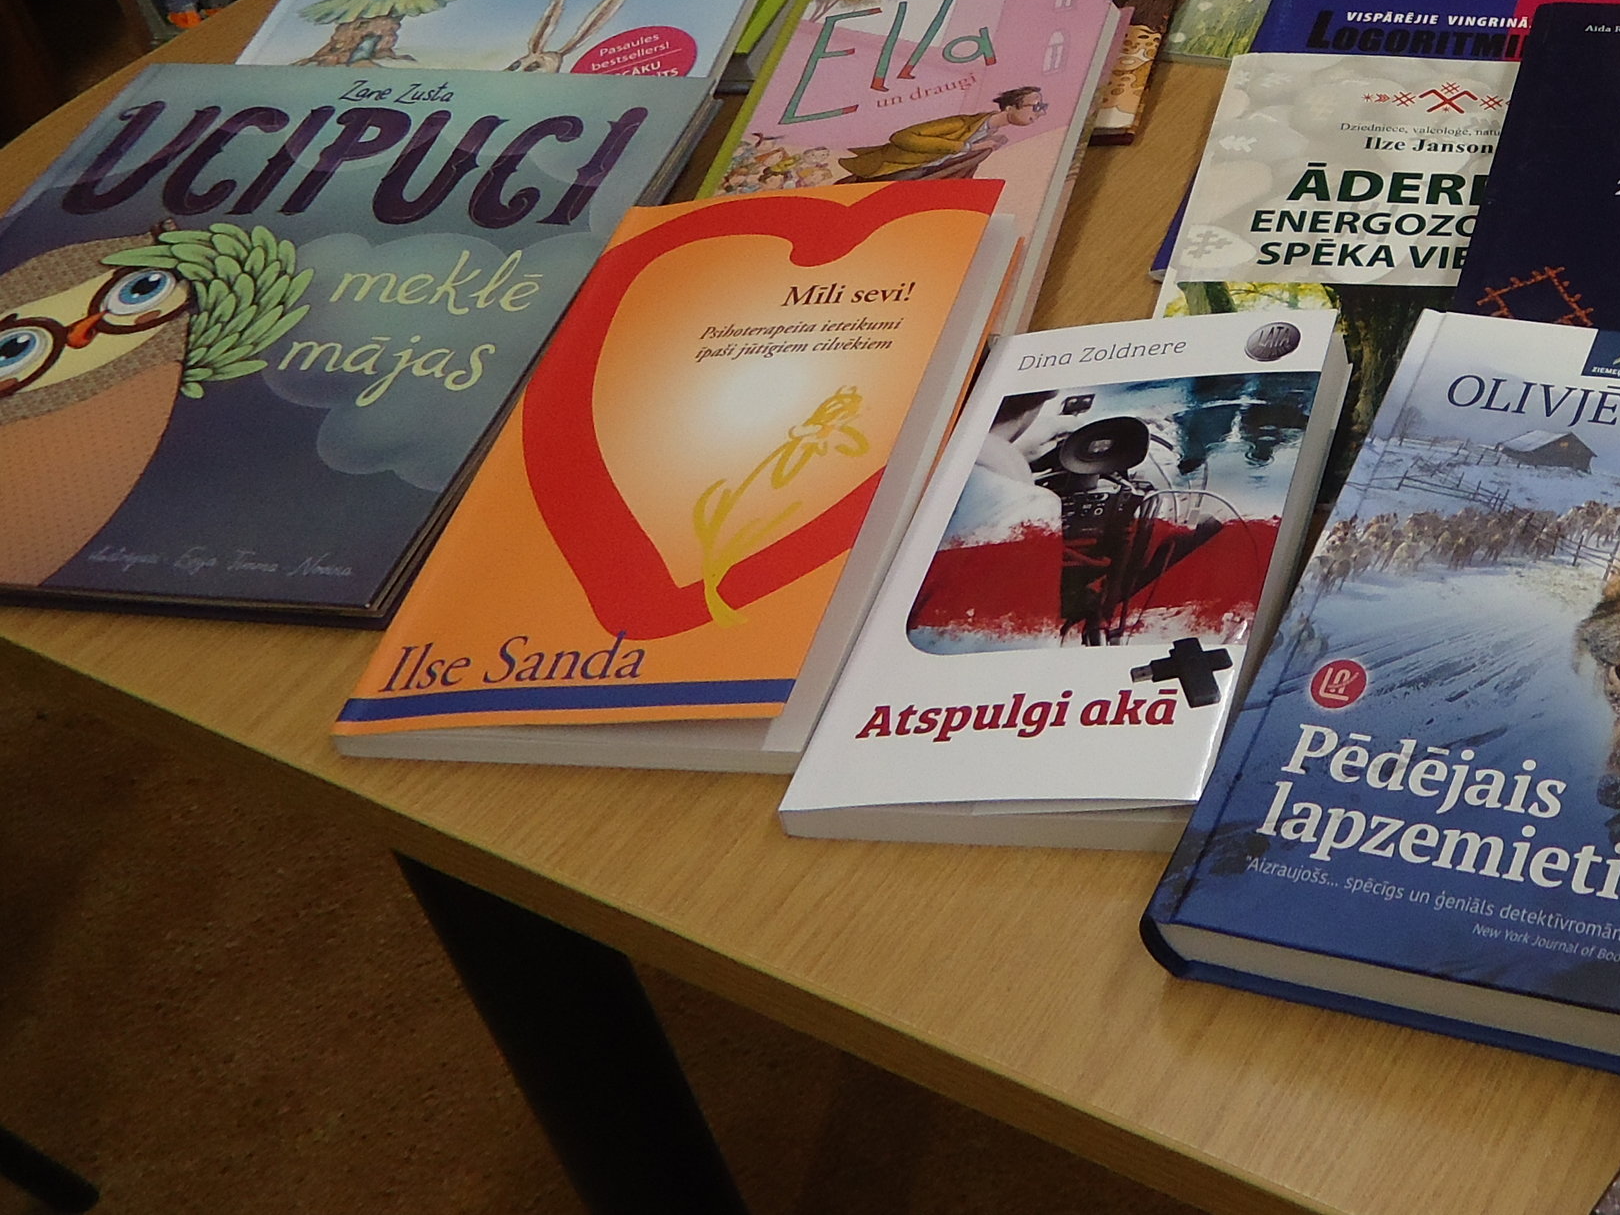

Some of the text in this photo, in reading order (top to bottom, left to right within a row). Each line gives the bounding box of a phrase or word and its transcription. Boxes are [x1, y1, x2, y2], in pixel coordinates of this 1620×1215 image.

[600, 34, 660, 56] Pasaules
[1584, 24, 1612, 33] Aida
[339, 79, 455, 105] Zane Zusta
[876, 72, 977, 108] un draugi
[1340, 123, 1408, 134] Dziedniece,
[1364, 137, 1406, 151] Ilze
[61, 99, 650, 230] UCIPUCI
[1256, 238, 1396, 268] SPĒKA
[328, 250, 546, 316] meklē
[781, 282, 916, 307] Mīli sevi!
[699, 317, 904, 340] Psihoterapeita ieteikumi
[695, 337, 894, 363] īpaši jūtīgiem cilvēkiem
[1017, 338, 1188, 373] Dina Zoldnere
[277, 337, 496, 407] mājas
[378, 629, 649, 694] Ilse Sanda
[855, 690, 1178, 744] Atspulgi akā
[1281, 721, 1569, 822] Pēdējais
[1246, 855, 1340, 888] "Aizraujošs...
[1344, 875, 1405, 901] spēcīgs
[1409, 890, 1430, 905] un
[1434, 889, 1494, 917] ģeniāls
[1472, 922, 1502, 938] New
[1505, 929, 1532, 945] York
[1532, 933, 1579, 956] Journal
[1580, 944, 1597, 957] of
